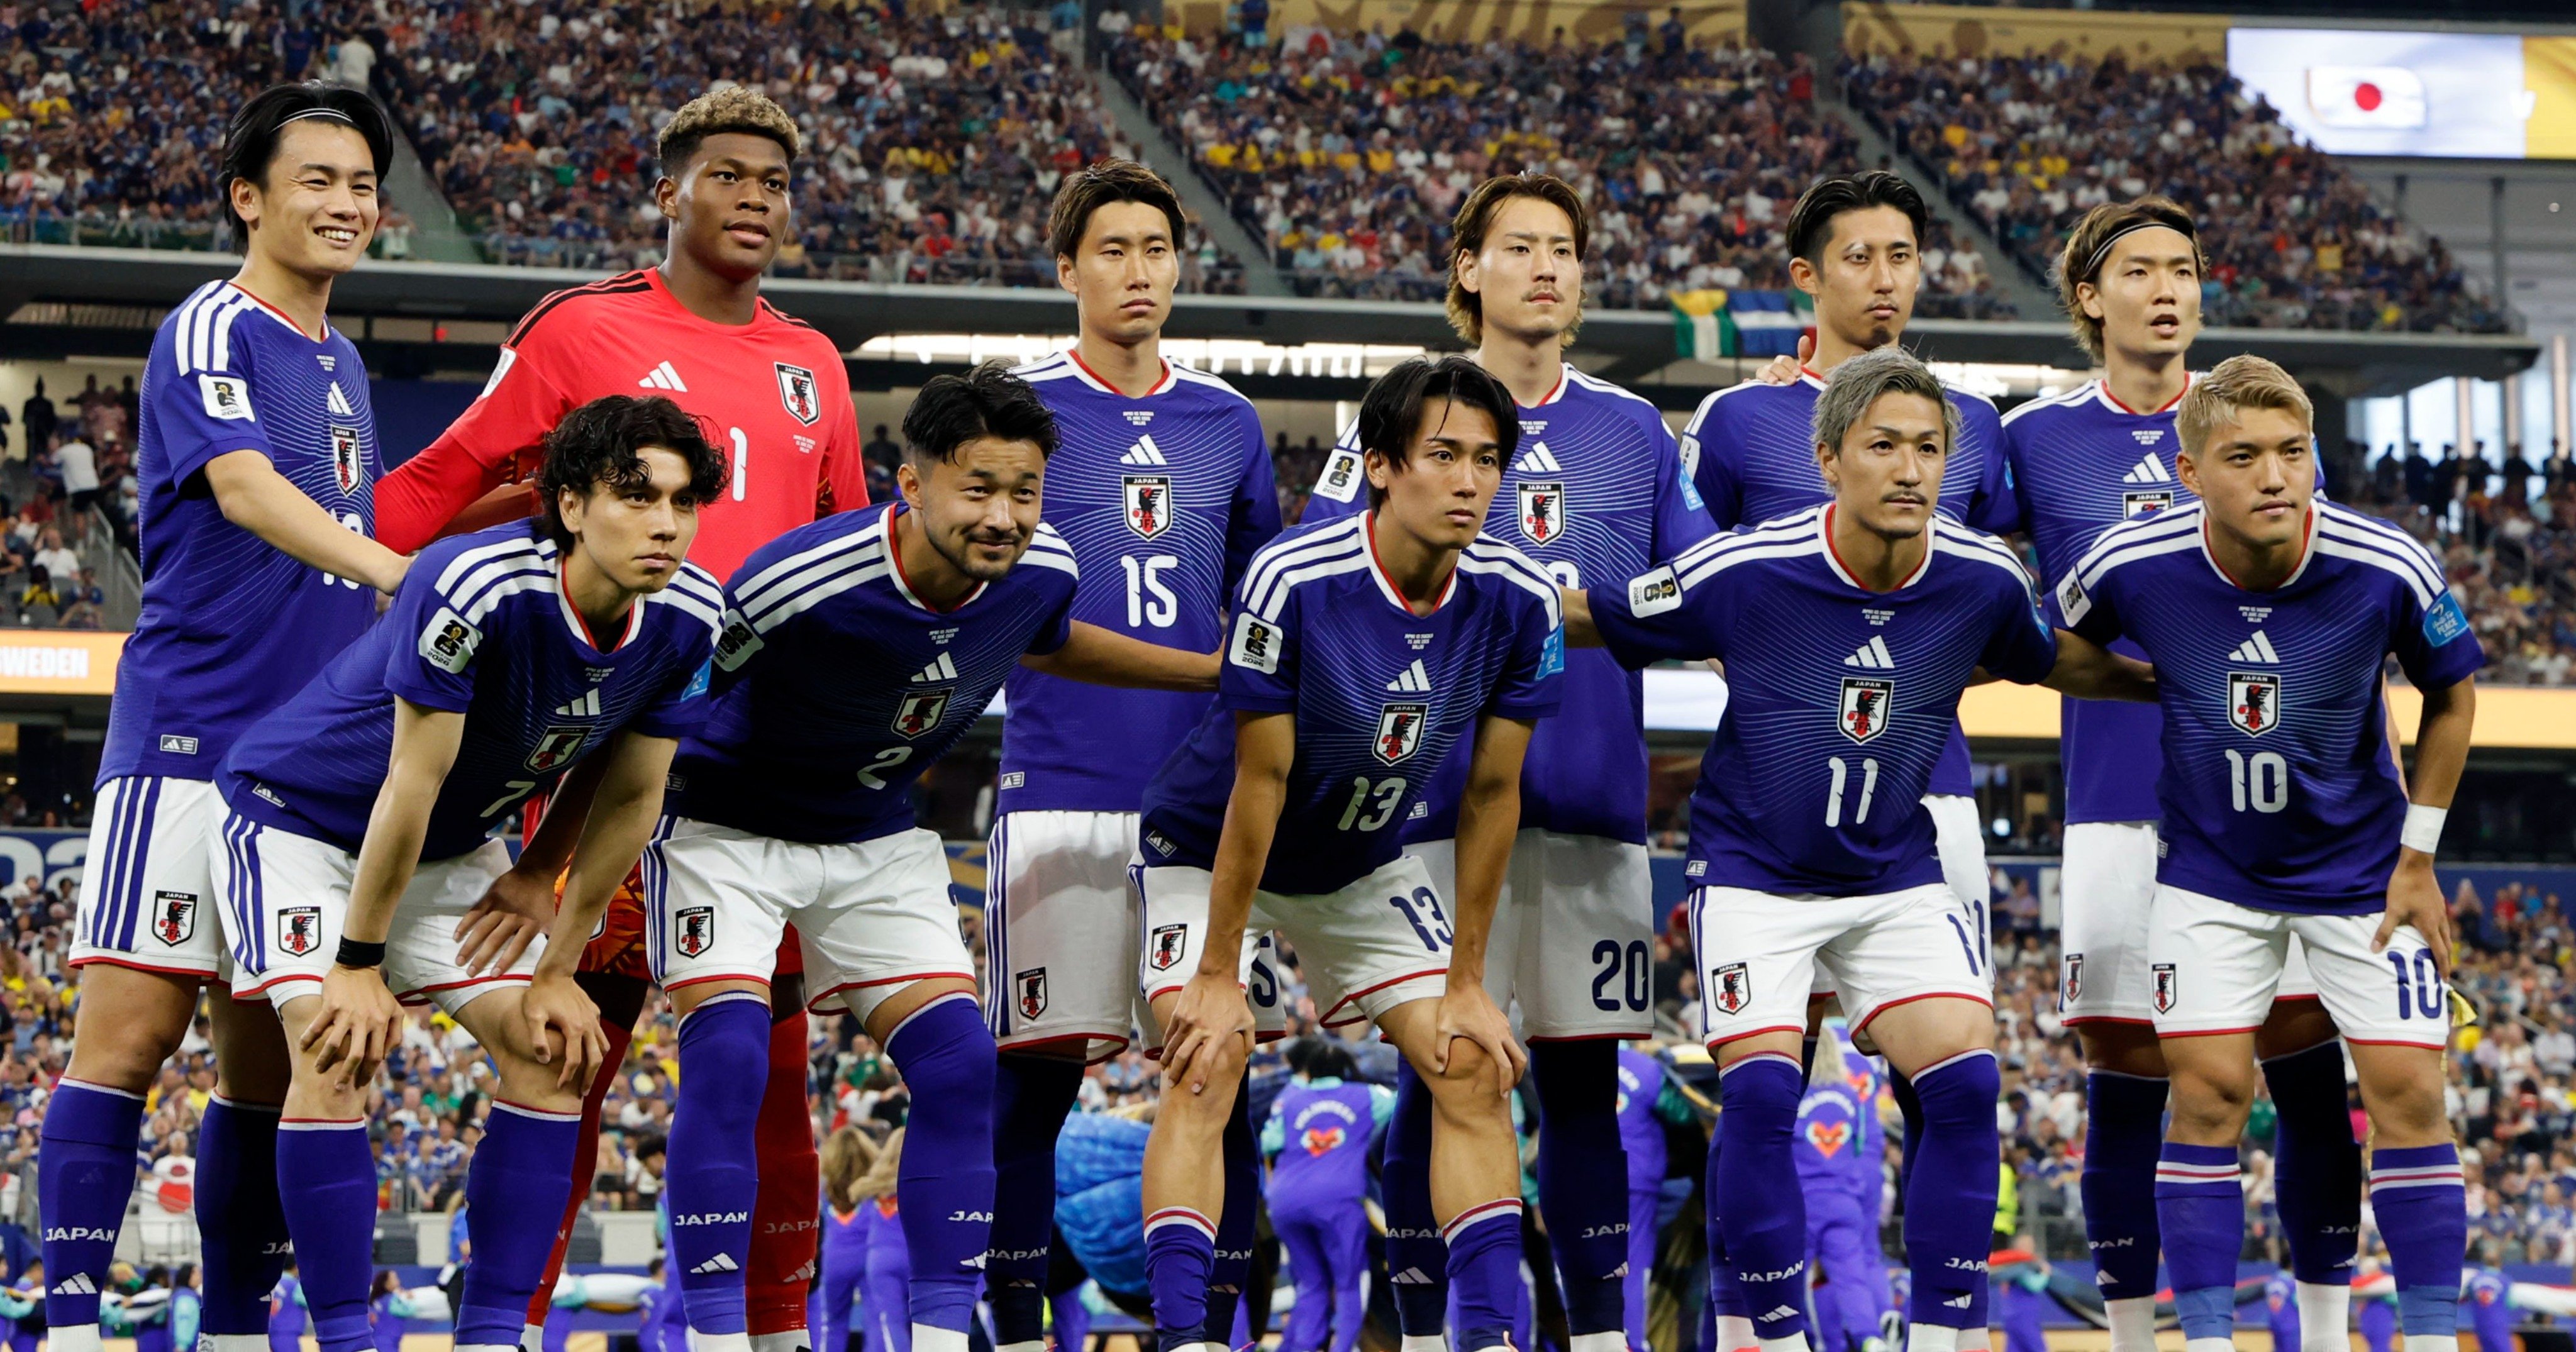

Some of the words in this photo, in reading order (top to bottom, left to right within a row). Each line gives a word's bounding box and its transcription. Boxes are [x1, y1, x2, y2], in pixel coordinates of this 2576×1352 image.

[785, 367, 804, 375] JAPAN
[730, 427, 747, 502] 1
[1138, 519, 1158, 528] JFA
[1531, 525, 1551, 535] JFA
[1121, 555, 1179, 628] 15
[440, 643, 451, 653] FIFA
[1250, 646, 1261, 655] FIFA
[0, 646, 89, 679] WEDEN
[427, 651, 449, 667] 2026
[1242, 657, 1264, 667] 2026
[857, 746, 913, 790] 2
[2225, 749, 2288, 813] 10
[482, 781, 536, 817] 7
[1826, 757, 1879, 828] 11
[1338, 777, 1407, 831] 13
[1390, 887, 1452, 951] 13
[289, 941, 309, 950] JFA
[1592, 940, 1649, 1012] 20
[1719, 965, 1738, 973] JAPAN
[2387, 948, 2443, 1020] 10
[675, 1212, 748, 1226] JAPAN
[764, 1218, 820, 1233] JAPA
[46, 1227, 116, 1243] JAPAN
[2089, 1238, 2134, 1249] PAN
[986, 1246, 1048, 1260] JAPAN
[1214, 1249, 1253, 1260] PAN
[1739, 1260, 1804, 1282] JAPAN
